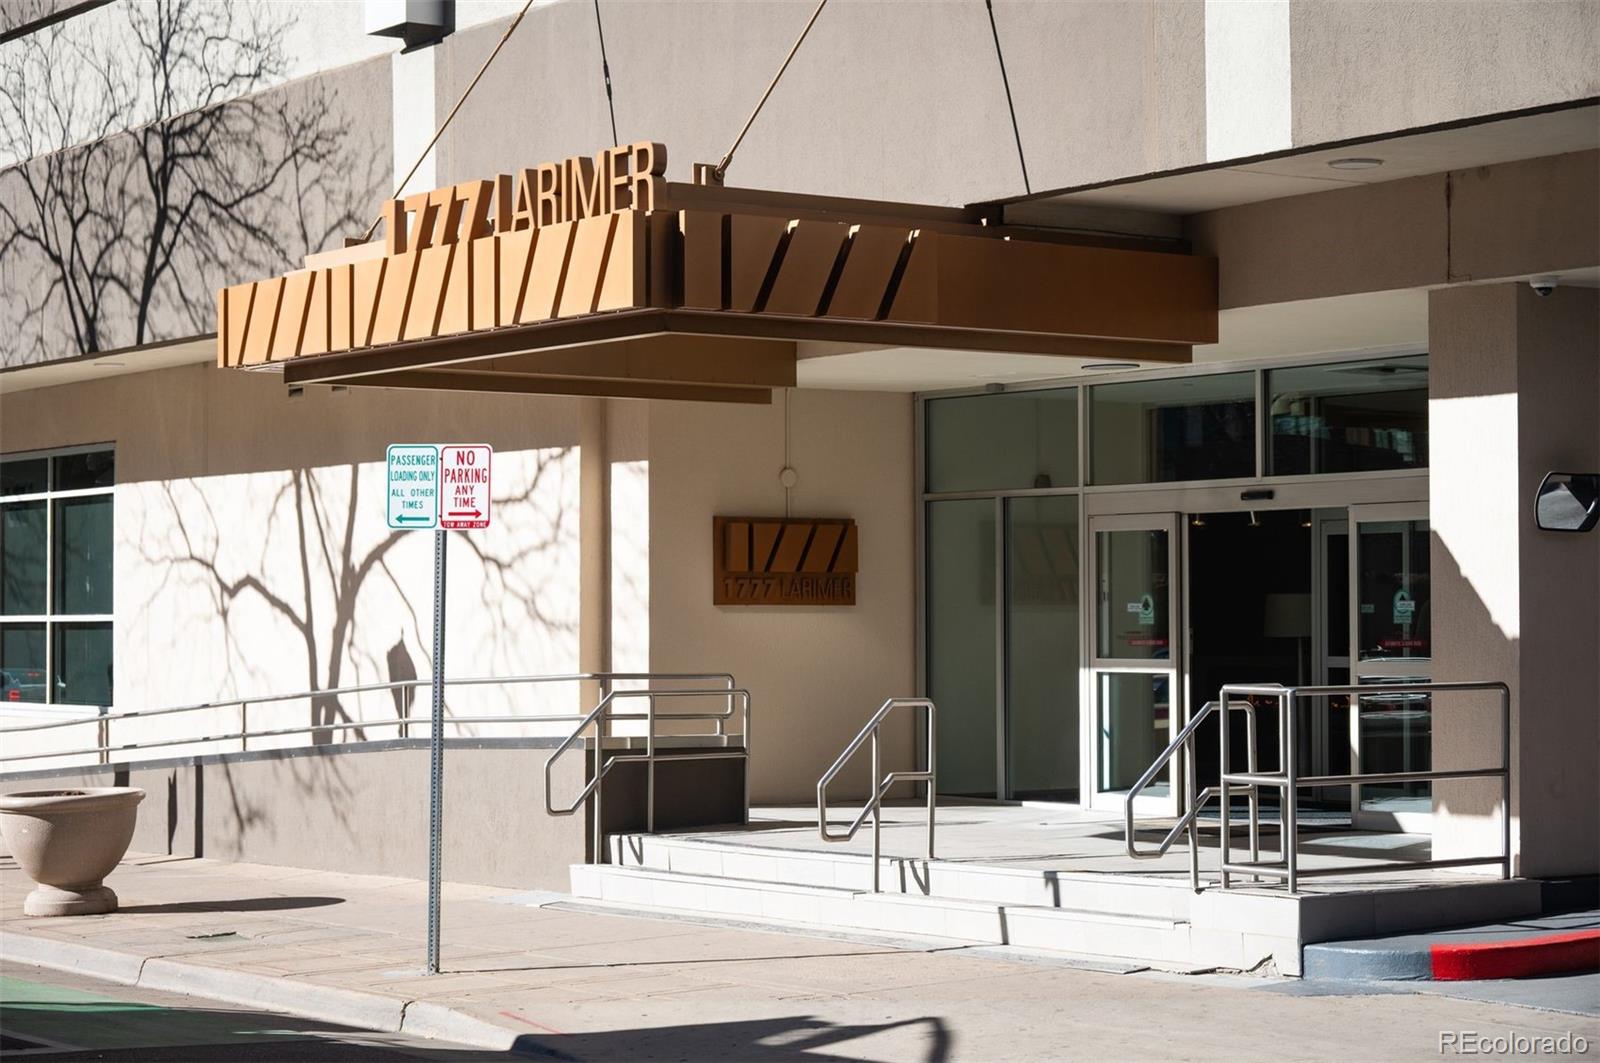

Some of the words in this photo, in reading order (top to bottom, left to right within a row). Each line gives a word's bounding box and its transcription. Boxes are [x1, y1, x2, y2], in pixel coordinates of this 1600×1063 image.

[379, 180, 494, 256] 1777
[493, 141, 666, 234] LARIMER
[390, 454, 436, 466] PASSENGER
[456, 450, 476, 466] NO
[390, 470, 418, 482] LOADING
[418, 470, 435, 482] ONLY
[444, 468, 488, 484] PARKING
[391, 488, 404, 497] ALL
[410, 488, 434, 497] OTHER
[454, 485, 475, 495] ANY
[401, 500, 424, 509] TIMES
[453, 497, 476, 508] TIME
[723, 576, 776, 599] 1777
[779, 576, 851, 600] LARIMER
